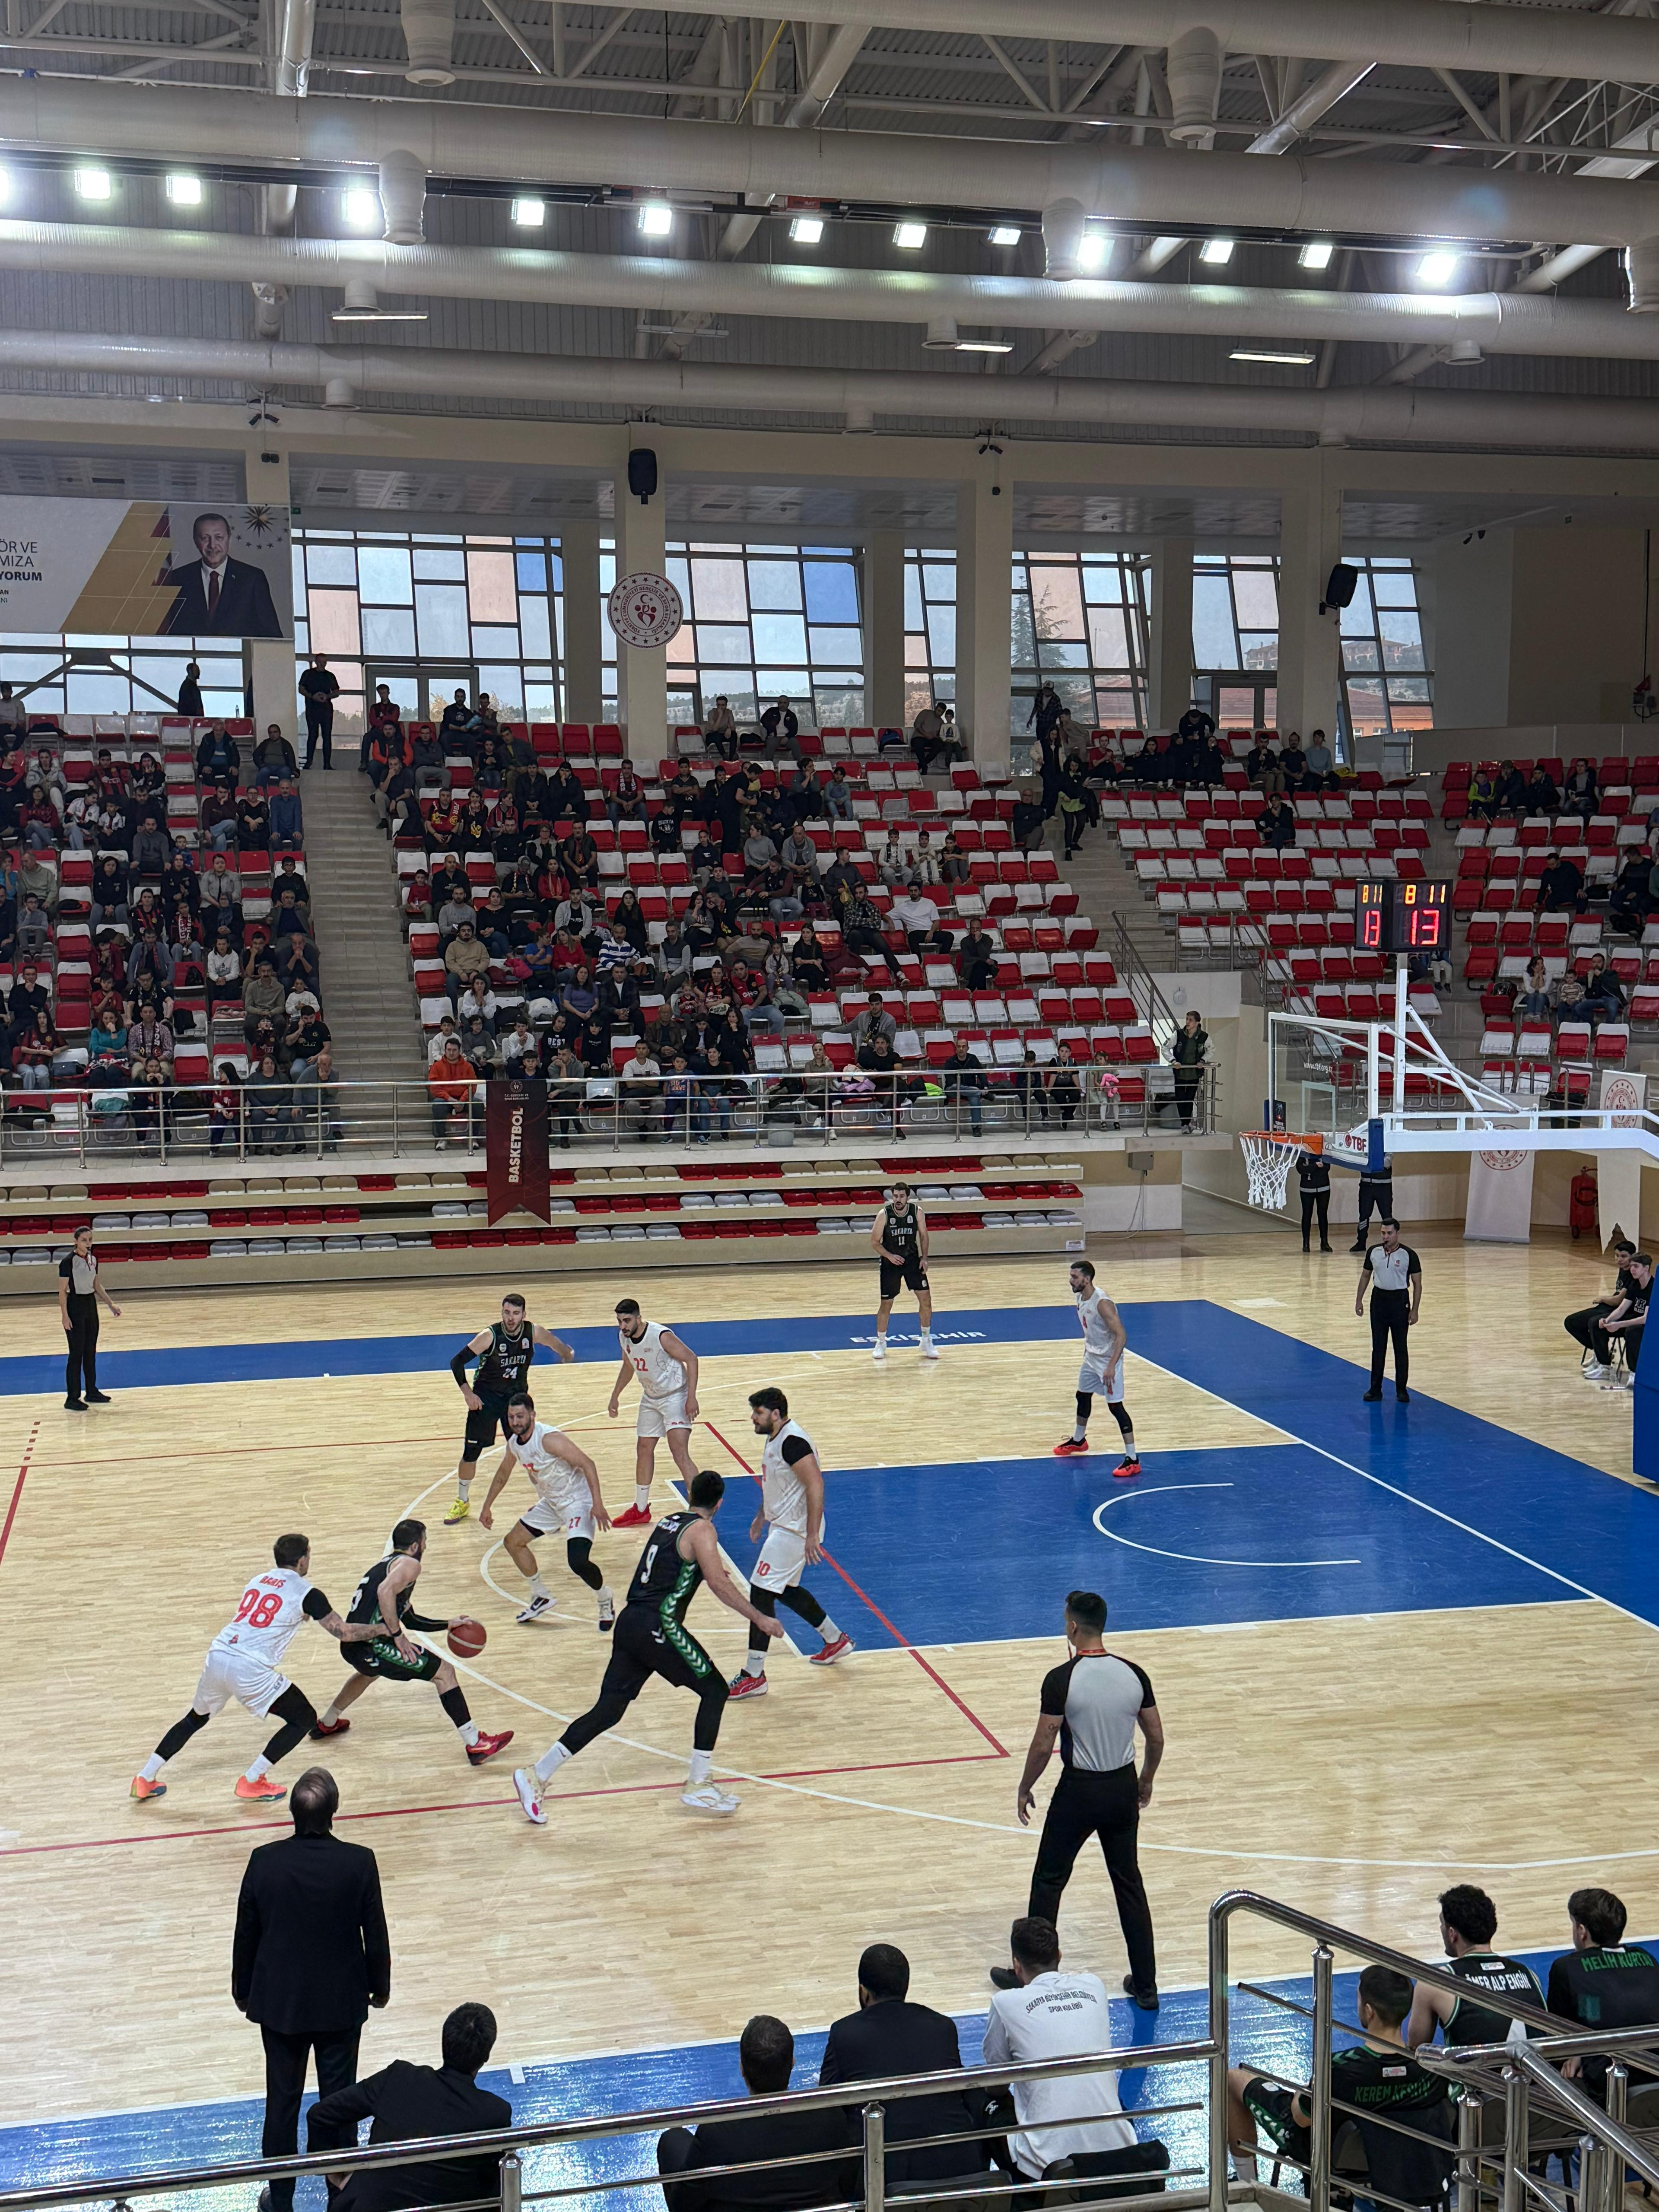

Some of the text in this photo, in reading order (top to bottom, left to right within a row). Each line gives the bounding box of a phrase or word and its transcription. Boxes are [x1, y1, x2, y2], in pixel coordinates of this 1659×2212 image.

[20, 542, 38, 553] VE
[1411, 910, 1440, 945] 13
[508, 1107, 524, 1183] BASKETBOL
[1351, 1135, 1367, 1152] TBF
[899, 1236, 905, 1246] 11
[502, 1367, 518, 1379] 24
[633, 1357, 648, 1372] 22
[569, 1516, 581, 1529] 27
[641, 1544, 658, 1584] 9
[756, 1560, 770, 1576] 10
[232, 1588, 283, 1628] 98
[1491, 1975, 1506, 1991] ALP
[1505, 1969, 1532, 1990] ENGİN
[1354, 2085, 1391, 2102] KEREM
